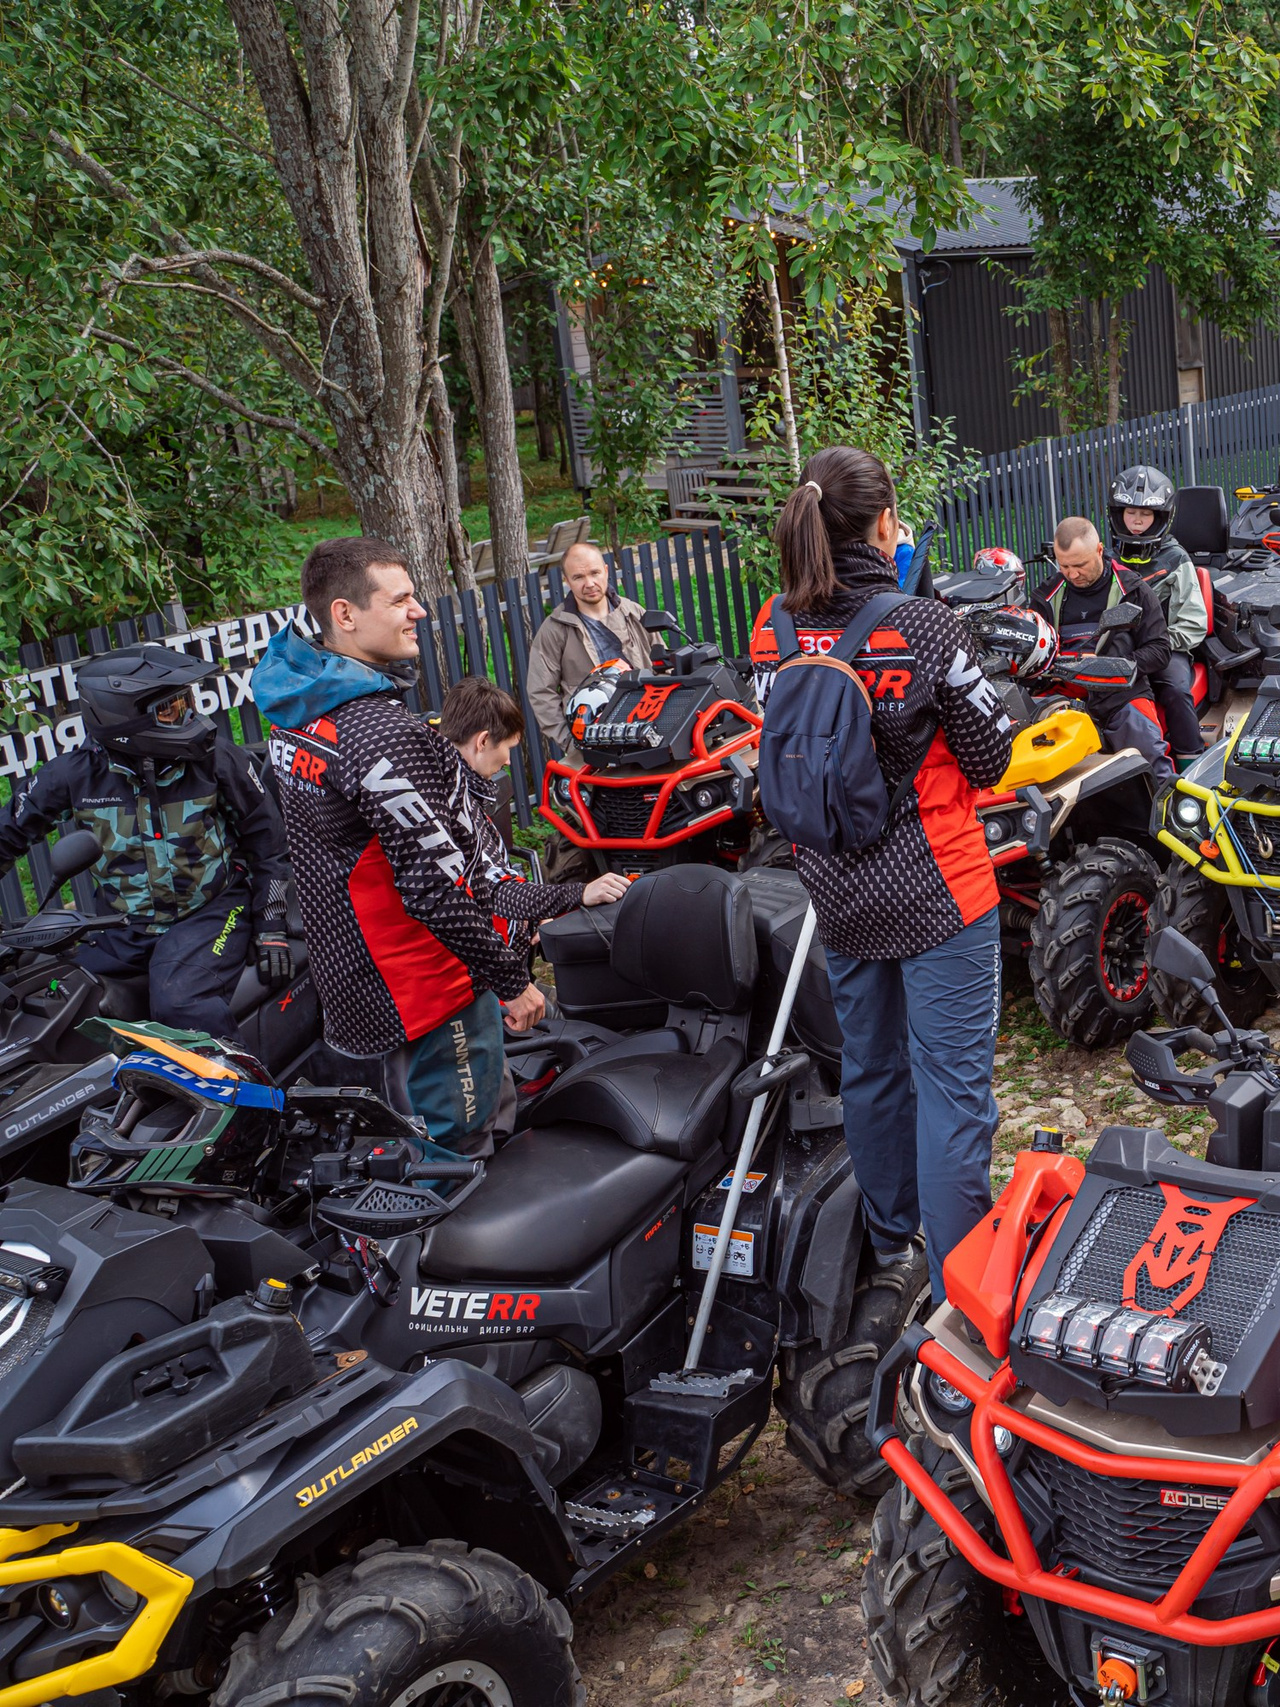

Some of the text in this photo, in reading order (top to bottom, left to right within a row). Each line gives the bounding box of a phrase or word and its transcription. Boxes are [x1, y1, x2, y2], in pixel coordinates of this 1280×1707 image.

[449, 1019, 477, 1124] FINNTRAIL
[5, 1083, 97, 1140] OUTLANDER
[409, 1287, 542, 1321] VETERR
[479, 1325, 511, 1336] ДИЛЕР
[515, 1326, 536, 1335] BRP
[295, 1415, 419, 1508] OUTLANDER
